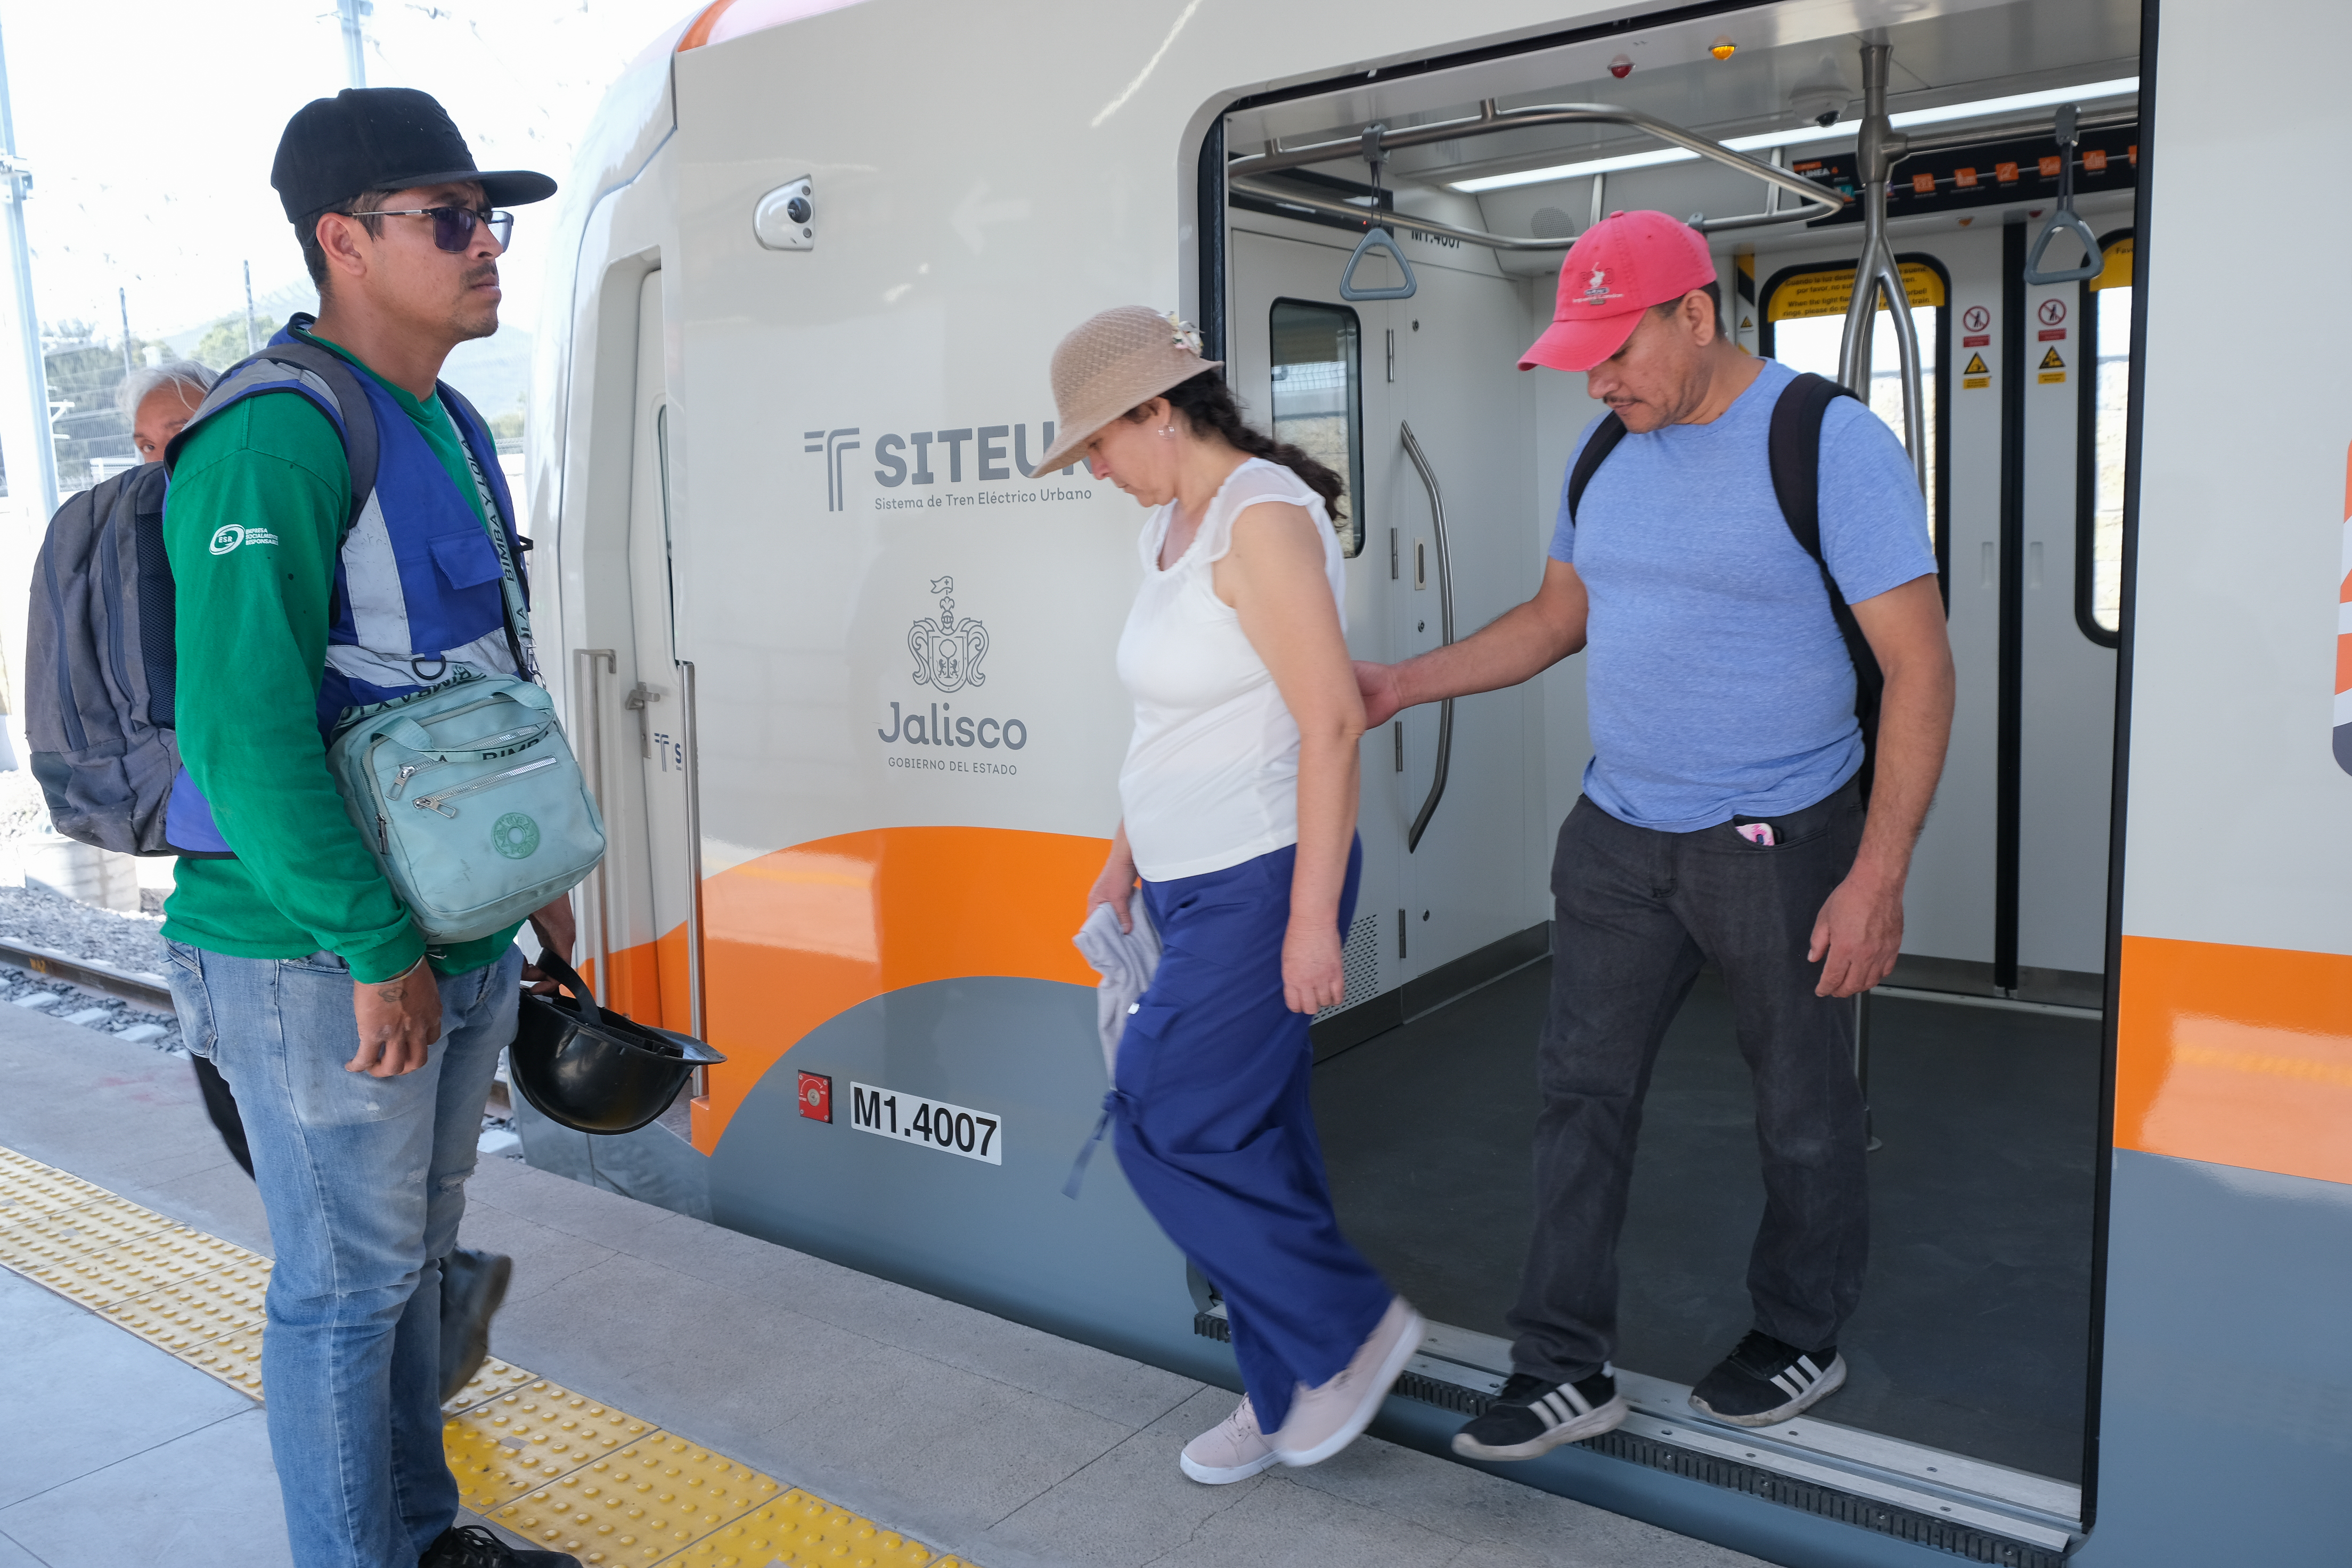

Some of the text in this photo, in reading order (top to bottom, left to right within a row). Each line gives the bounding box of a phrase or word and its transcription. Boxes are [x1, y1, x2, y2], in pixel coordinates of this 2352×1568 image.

[1804, 306, 1827, 316] please
[481, 492, 492, 507] Y
[875, 488, 1092, 510] Sistema de Tren Eléctrico Urbano
[489, 514, 515, 582] BIMBA
[878, 701, 1027, 750] Jalisco
[888, 757, 1017, 775] GOBIERNO DEL ESTADO
[854, 1087, 997, 1157] M1.4007
